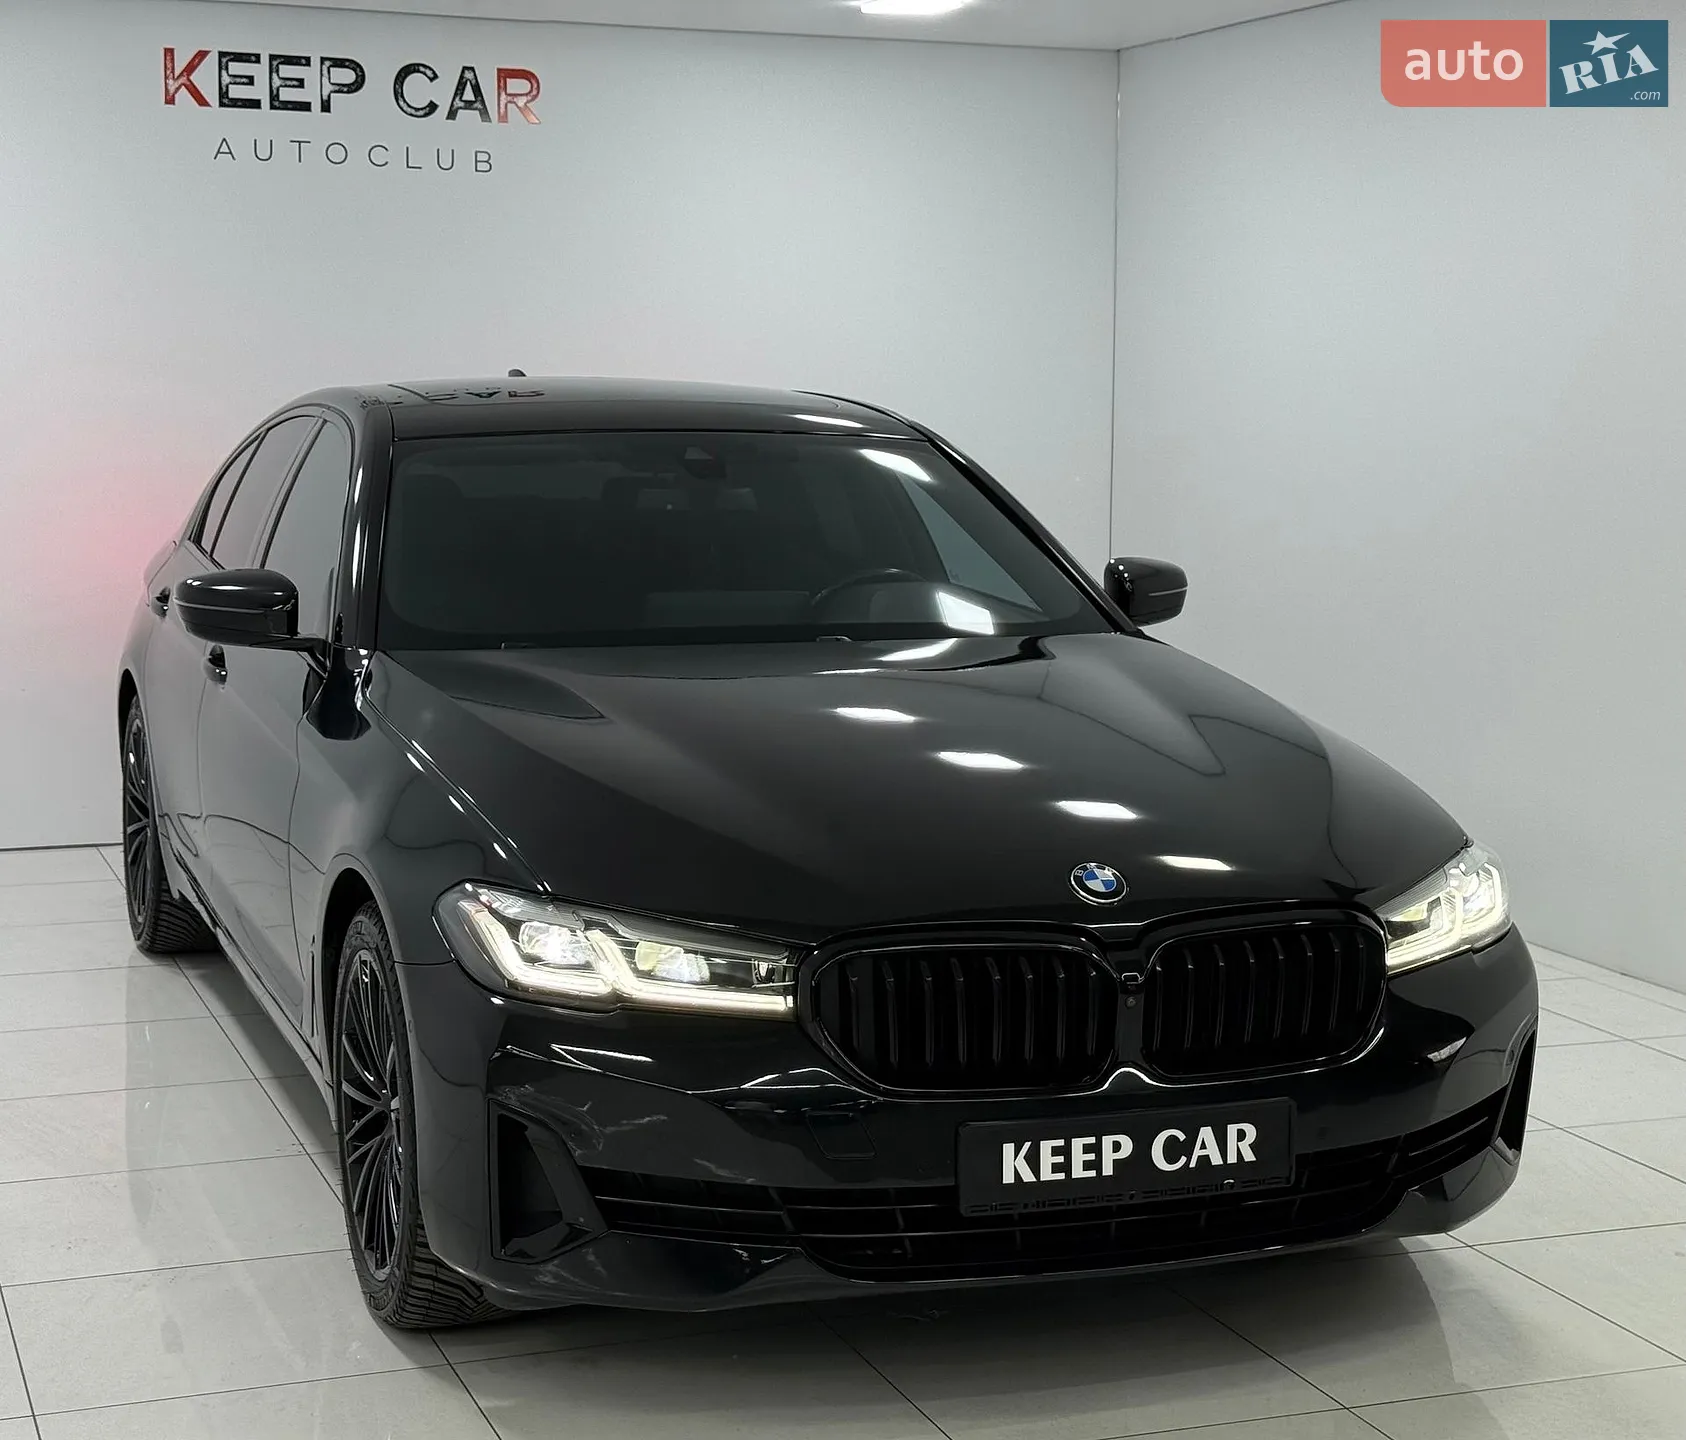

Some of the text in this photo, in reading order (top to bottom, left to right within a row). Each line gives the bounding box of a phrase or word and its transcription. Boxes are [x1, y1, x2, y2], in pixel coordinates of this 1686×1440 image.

[163, 47, 542, 124] KEEP CAR
[214, 138, 493, 173] AUTOCLUB
[1002, 1123, 1257, 1184] KEEP CAR
